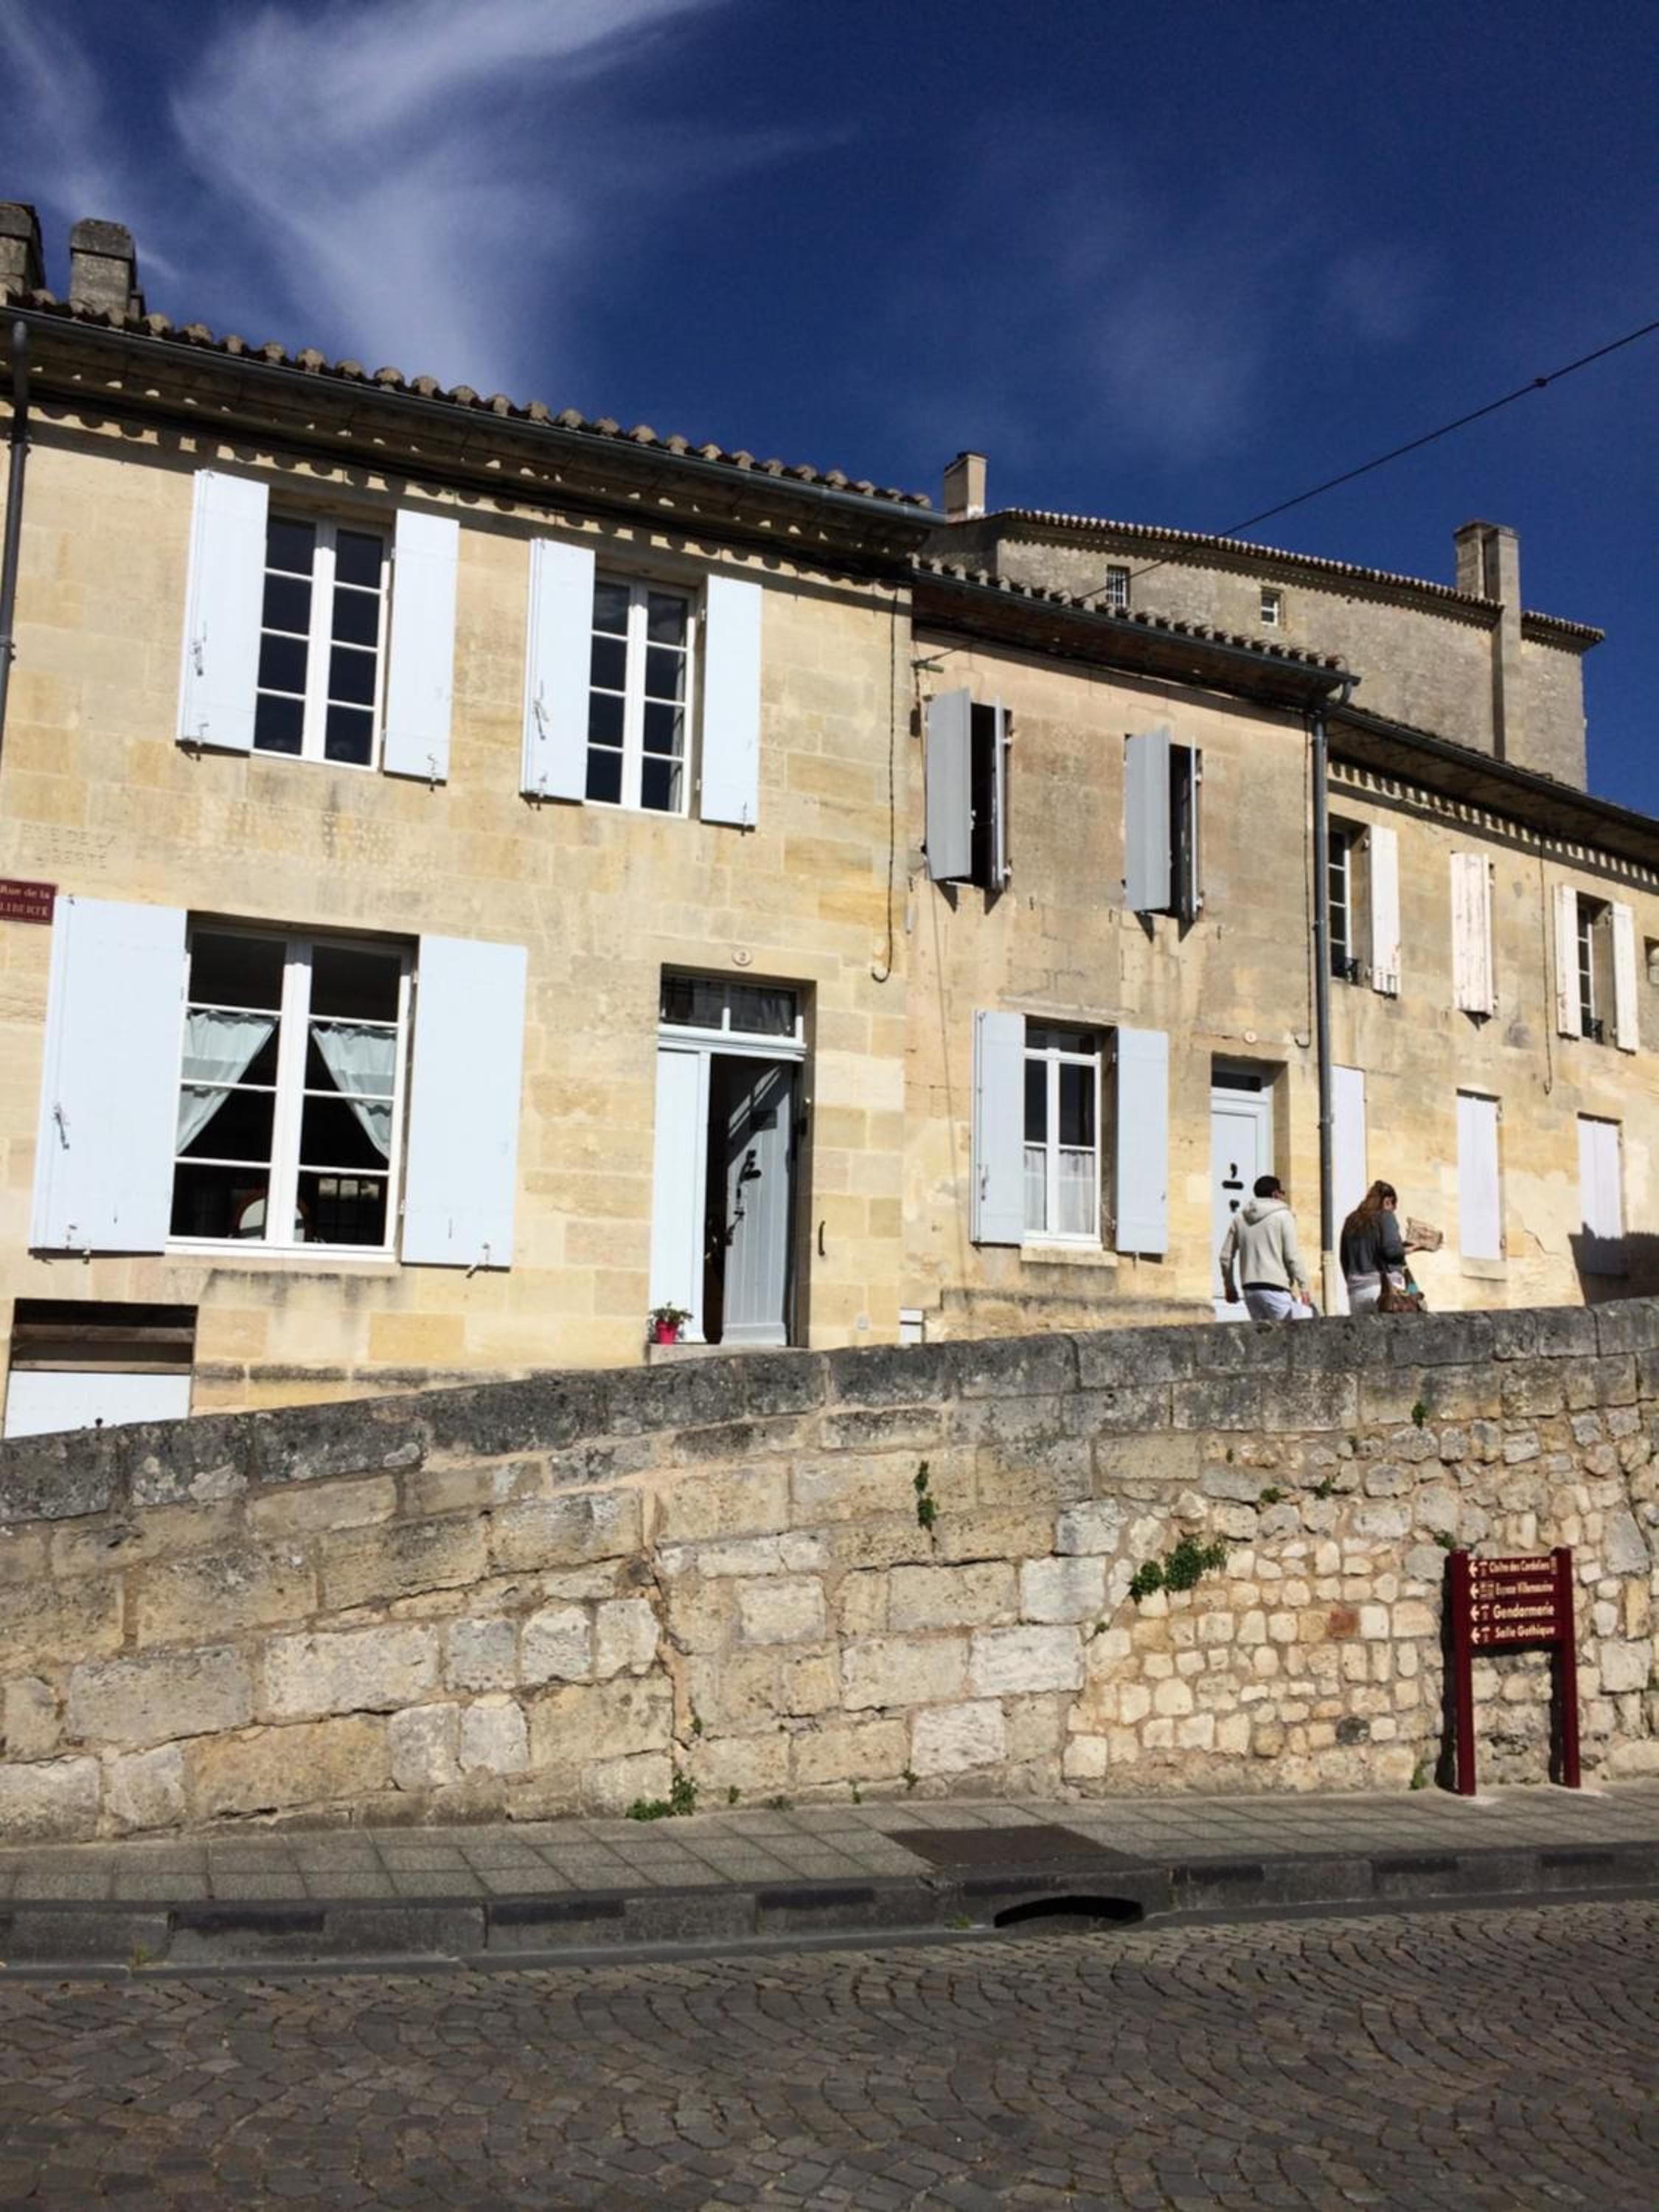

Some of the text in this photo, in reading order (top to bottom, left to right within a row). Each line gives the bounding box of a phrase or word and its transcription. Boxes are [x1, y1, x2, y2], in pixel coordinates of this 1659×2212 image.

[24, 888, 38, 898] de
[39, 889, 50, 900] la
[1492, 1602, 1555, 1619] Gendarmerie
[1495, 1624, 1556, 1638] Salle Gothique
